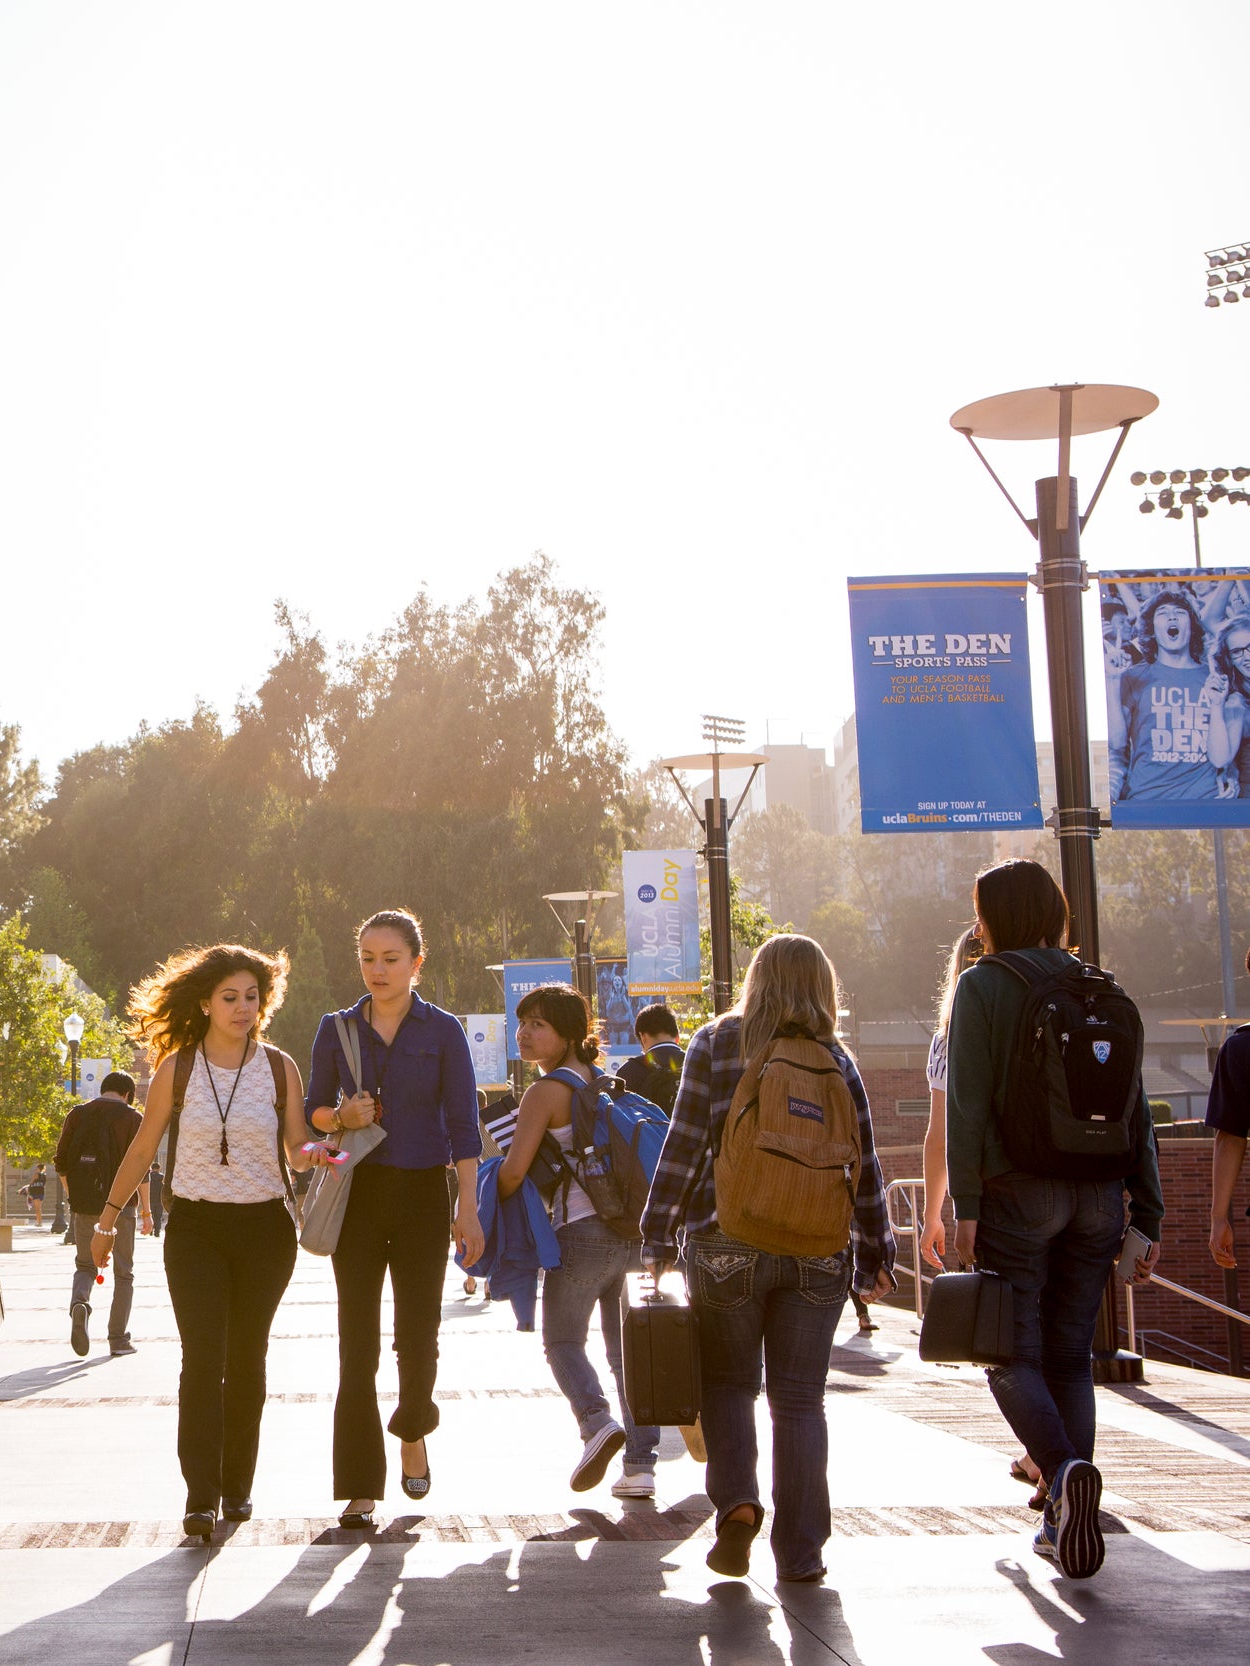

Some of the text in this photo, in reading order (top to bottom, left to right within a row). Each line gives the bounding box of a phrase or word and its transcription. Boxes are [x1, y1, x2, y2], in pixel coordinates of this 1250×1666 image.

[868, 633, 1012, 656] THE DEN
[895, 656, 988, 668] SPORTS PASS
[890, 674, 991, 684] YOUR SEASON PASS
[892, 683, 991, 694] TO UCLA FOOTBALL
[882, 693, 1006, 704] AND MEN'S BASKETBALL
[1151, 687, 1210, 707] UCLA
[1151, 706, 1210, 730] THE
[1151, 728, 1209, 753] DEN
[917, 800, 987, 810] SIGN UP TODAY AT
[661, 858, 682, 979] Alumni Day
[641, 907, 659, 957] UCLA
[631, 984, 700, 994] alumniday.ucla.edu
